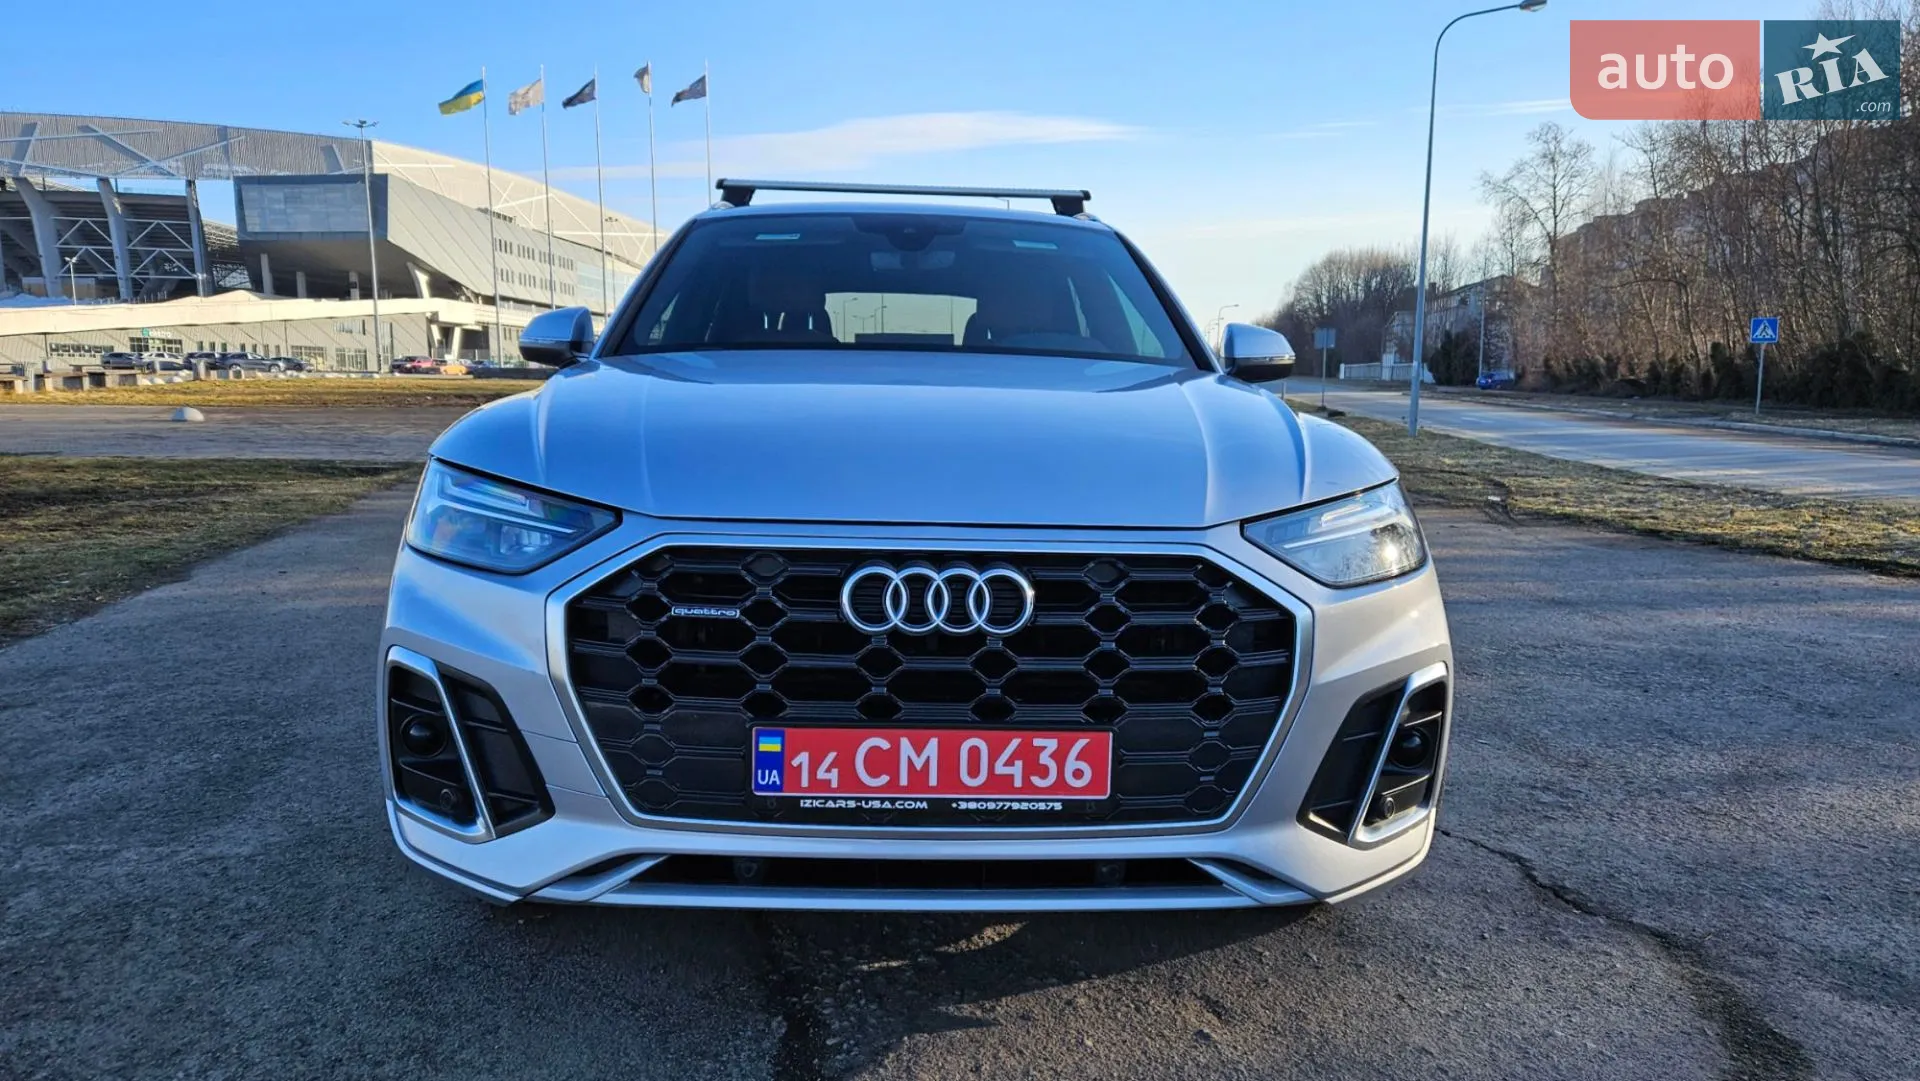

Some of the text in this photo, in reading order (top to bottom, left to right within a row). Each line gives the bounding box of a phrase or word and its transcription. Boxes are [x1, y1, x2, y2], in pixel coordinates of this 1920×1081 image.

[674, 607, 736, 616] quattro
[791, 736, 1093, 788] 14 CM 0436
[757, 769, 781, 785] UA
[800, 799, 1063, 811] IZICARS-USA.COM +380977920575
